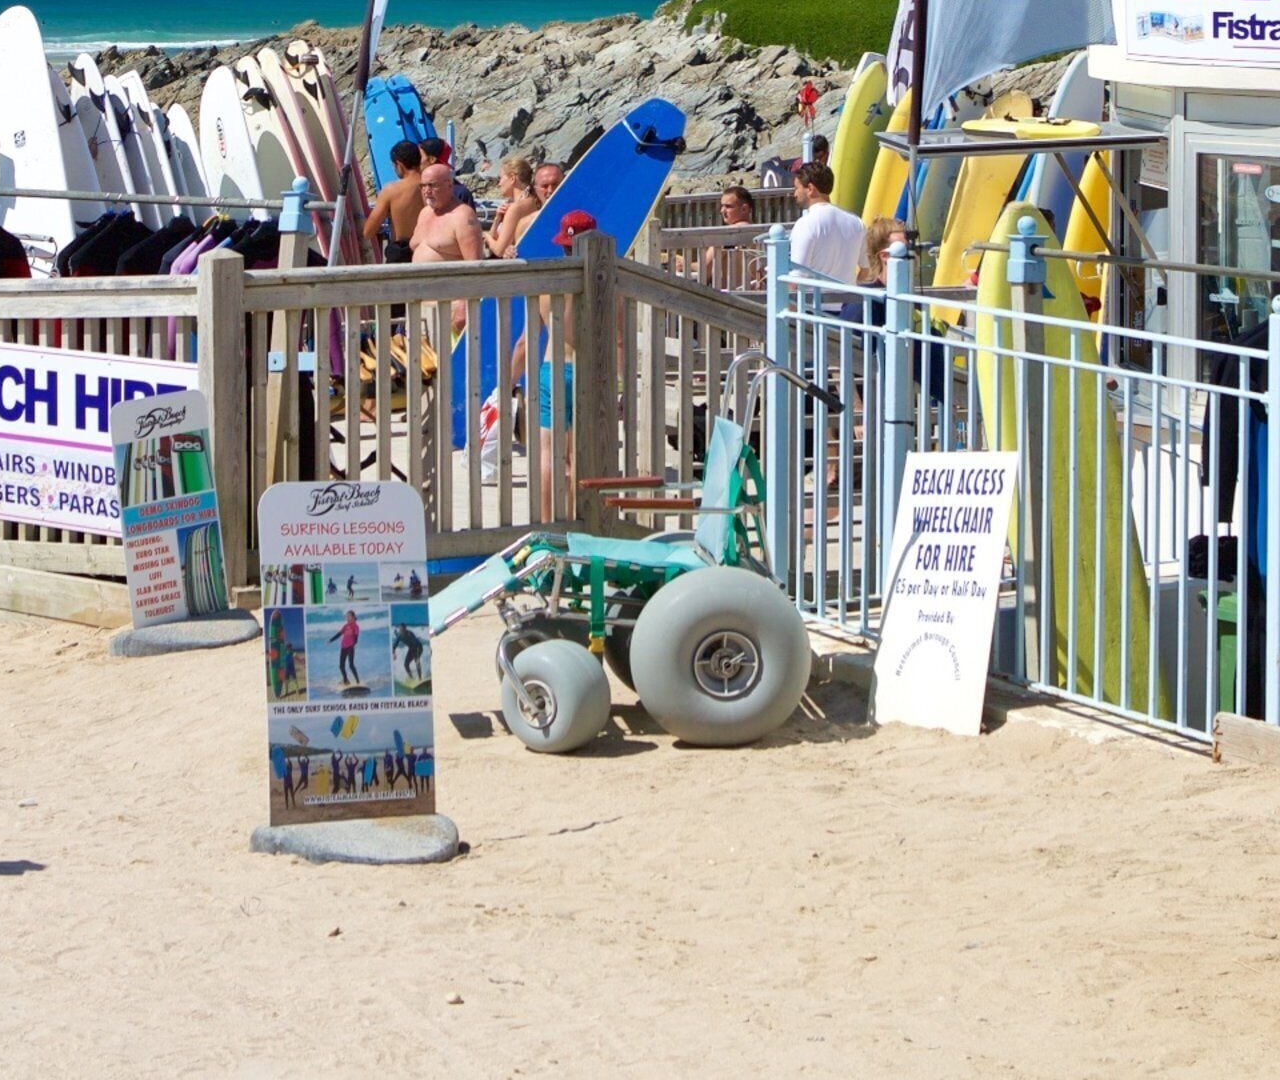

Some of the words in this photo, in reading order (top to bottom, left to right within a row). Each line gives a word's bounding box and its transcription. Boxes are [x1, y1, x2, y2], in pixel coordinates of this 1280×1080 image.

[53, 459, 116, 486] WINDB
[912, 468, 953, 496] BEACH
[956, 468, 1005, 496] ACCESS
[59, 492, 120, 519] PARAS
[281, 522, 340, 536] SURFING
[343, 521, 405, 534] LESSONS
[912, 506, 994, 534] WHEELCHAIR
[155, 546, 169, 556] STAR
[284, 543, 356, 557] AVAILABLE
[360, 542, 404, 554] TODAY
[915, 544, 942, 570] FOR
[944, 544, 976, 572] HIRE
[907, 583, 921, 596] per
[923, 579, 939, 598] Day
[941, 585, 949, 595] or
[952, 580, 969, 596] Half
[971, 581, 987, 600] Day
[287, 706, 303, 714] ONLY
